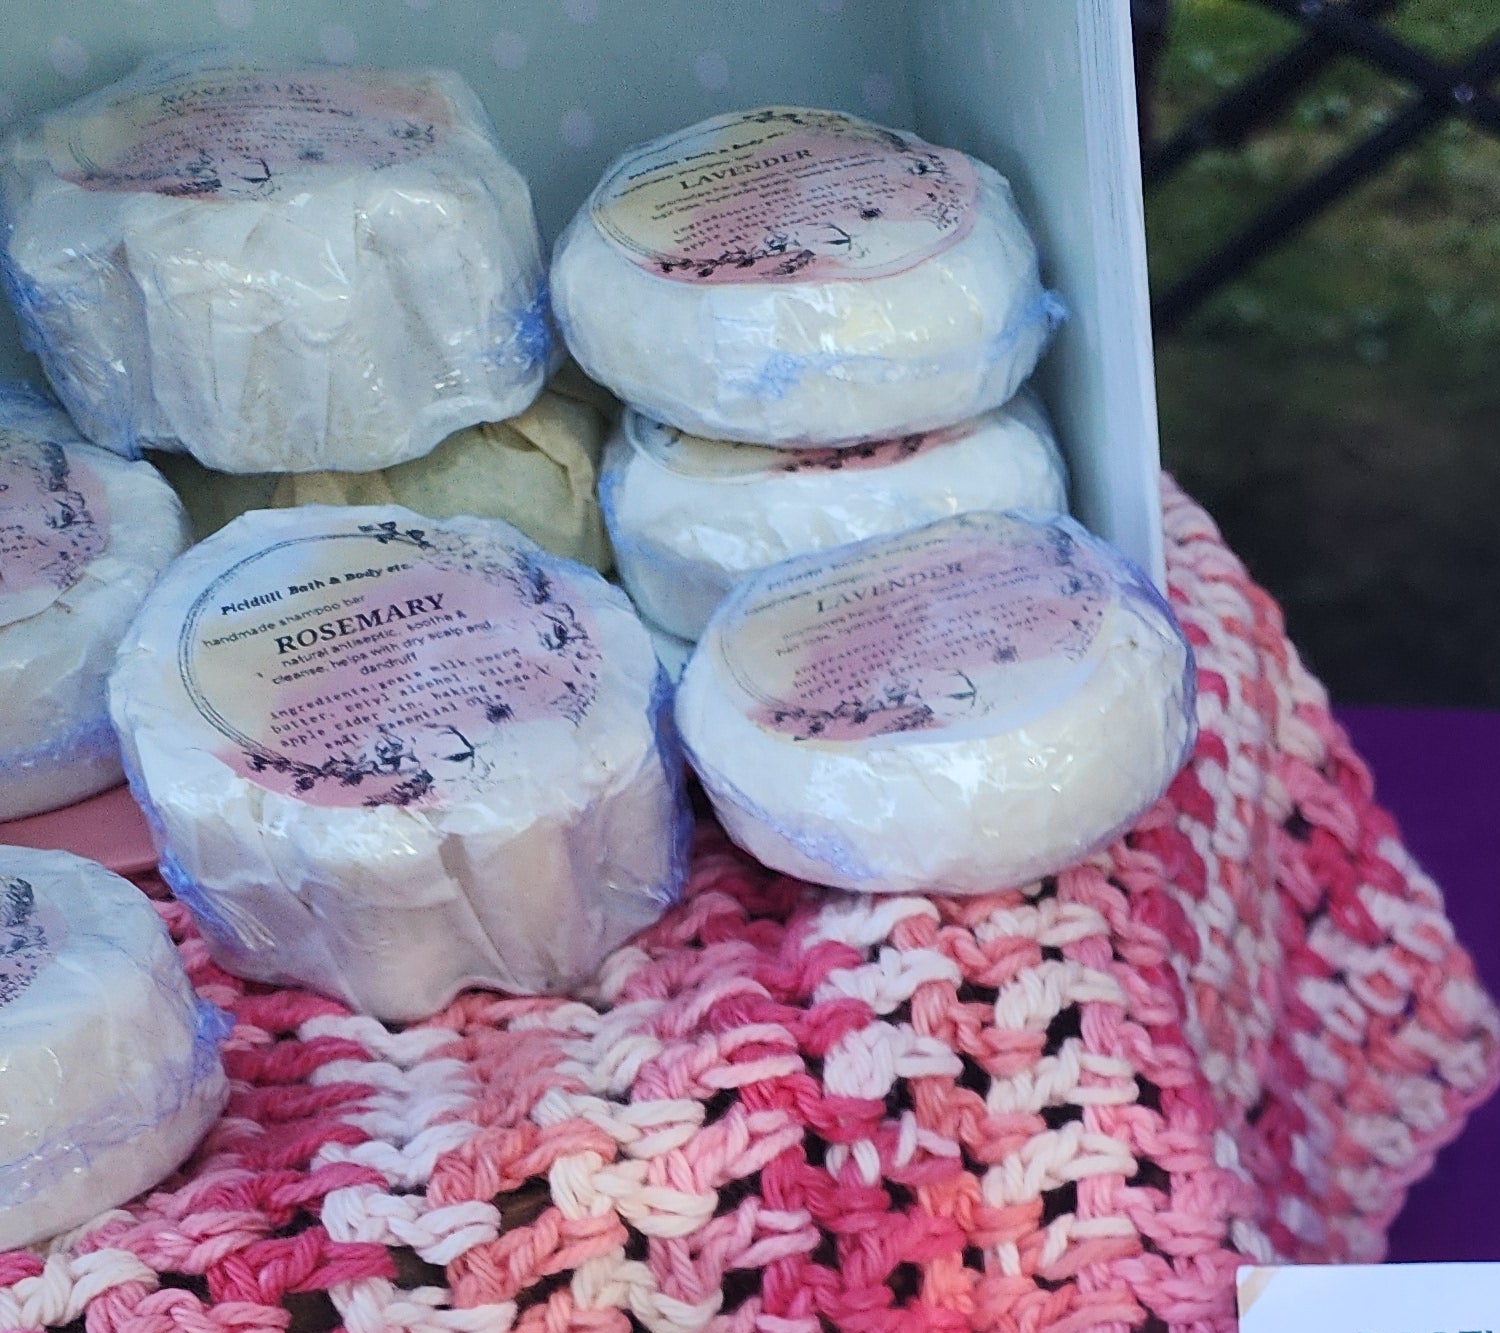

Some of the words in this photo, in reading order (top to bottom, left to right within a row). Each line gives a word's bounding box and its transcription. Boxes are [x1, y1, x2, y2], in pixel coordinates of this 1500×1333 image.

[679, 149, 812, 191] LAVENDER
[815, 560, 965, 614] LAVENDER
[202, 620, 275, 650] handmade
[278, 600, 342, 629] shampoo
[273, 591, 446, 655] ROSEMARY
[401, 634, 425, 652] dry
[281, 647, 328, 668] natural
